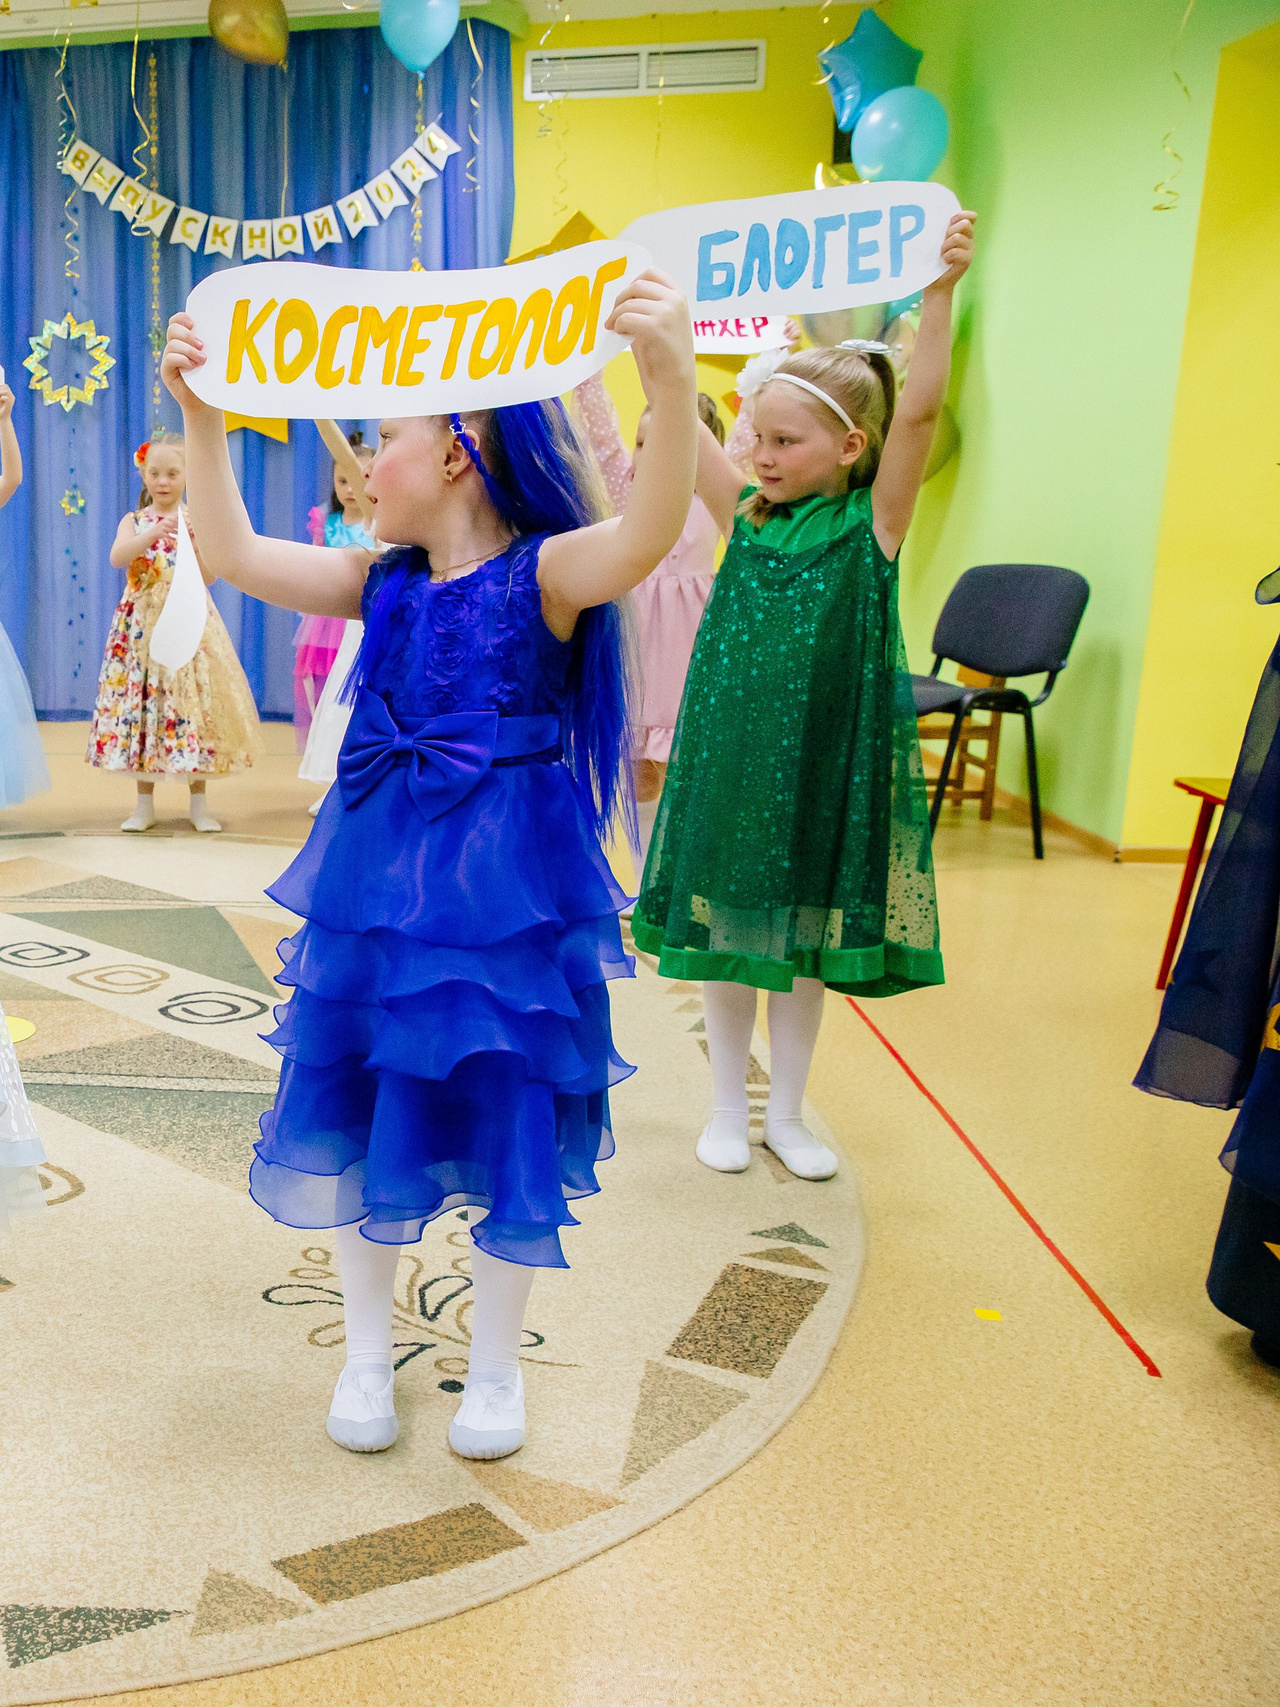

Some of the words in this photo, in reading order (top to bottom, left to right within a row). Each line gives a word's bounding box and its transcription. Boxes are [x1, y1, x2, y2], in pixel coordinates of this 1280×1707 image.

[71, 147, 333, 249] ВЫПУСКНОЙ
[347, 131, 448, 223] 2024
[697, 205, 925, 301] БЛОГЕР
[226, 256, 628, 390] КОСМЕТОЛОГ
